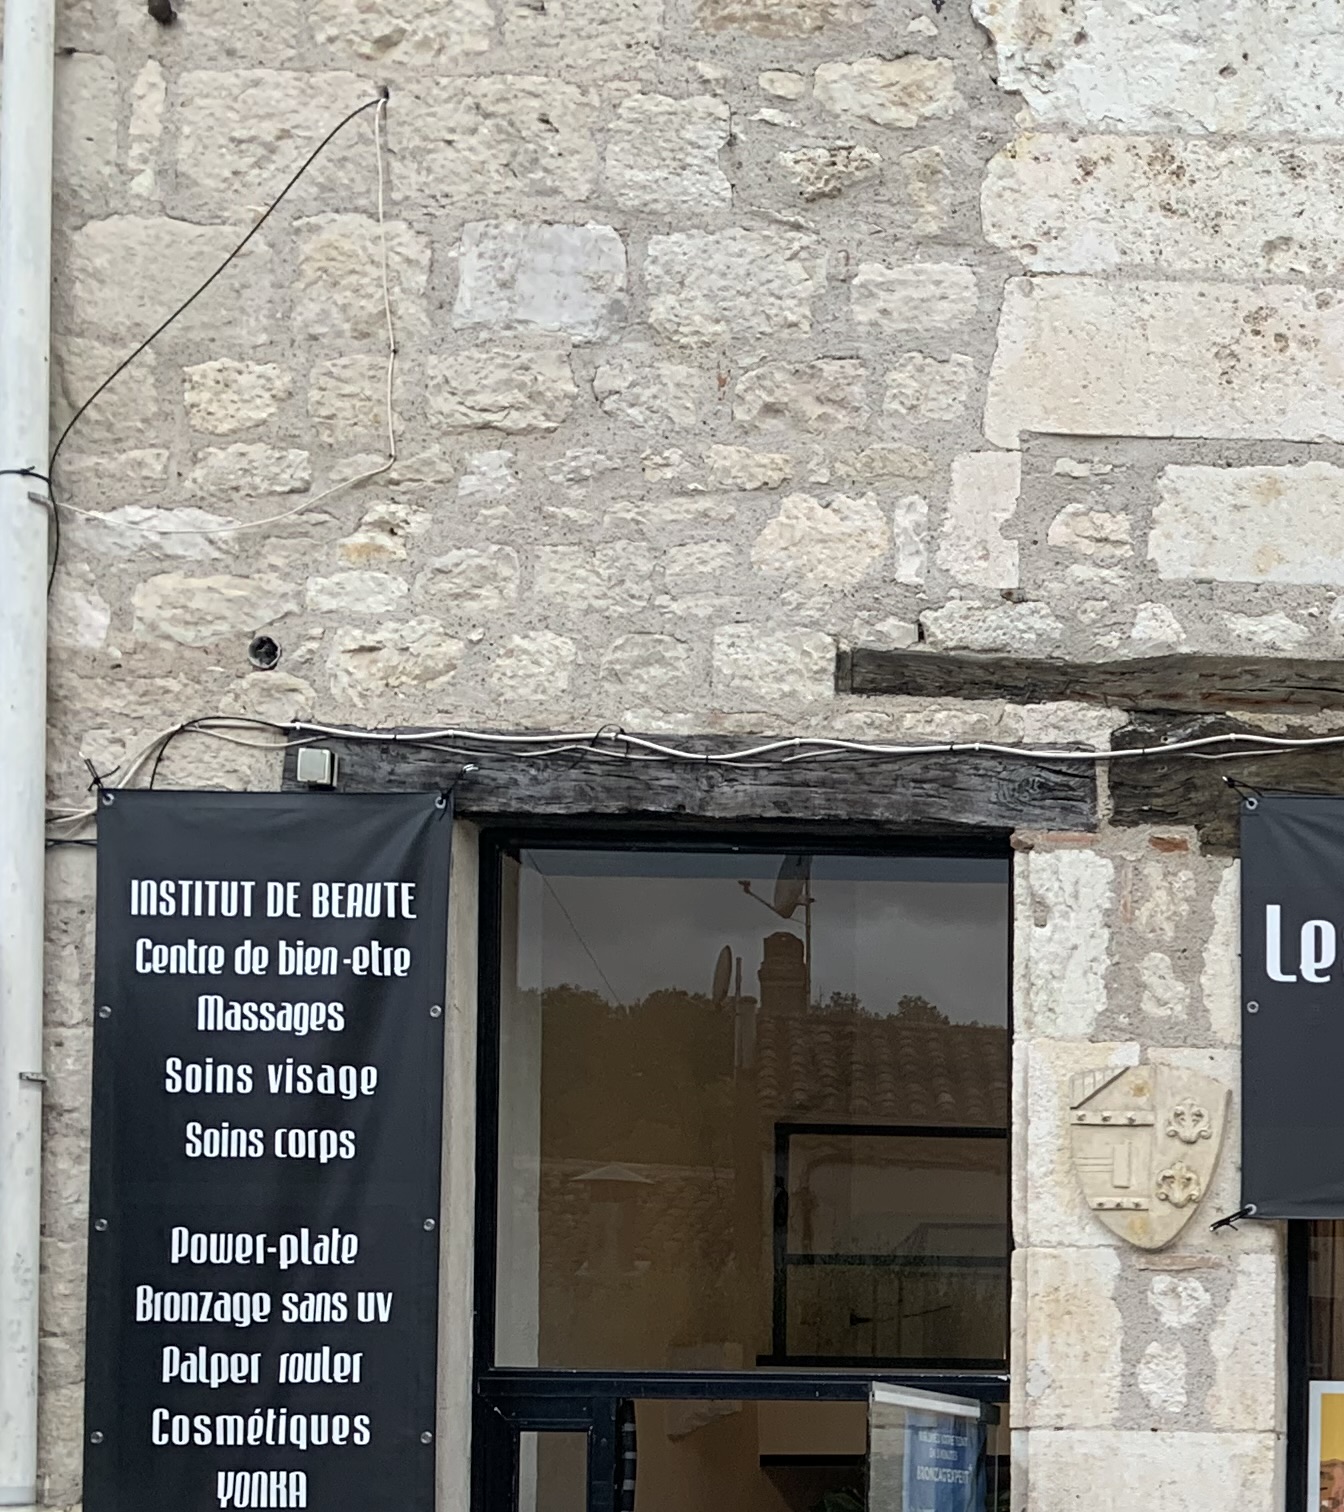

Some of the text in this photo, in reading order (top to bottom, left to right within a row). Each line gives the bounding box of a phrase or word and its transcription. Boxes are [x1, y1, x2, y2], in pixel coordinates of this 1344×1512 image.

[131, 880, 416, 918] INSTITUT DE BEAUTE
[136, 939, 224, 974] Centre
[235, 940, 268, 974] de
[279, 941, 337, 975] bien
[198, 995, 344, 1035] Massages
[166, 1058, 377, 1099] Soins visage
[186, 1122, 355, 1163] Soins corps
[172, 1227, 357, 1269] Power-plate
[137, 1285, 270, 1327] Bronzage
[283, 1292, 347, 1322] sans
[163, 1346, 362, 1388] Palper rouler
[153, 1408, 370, 1449] Cosmétiques
[218, 1471, 306, 1507] YONKA
